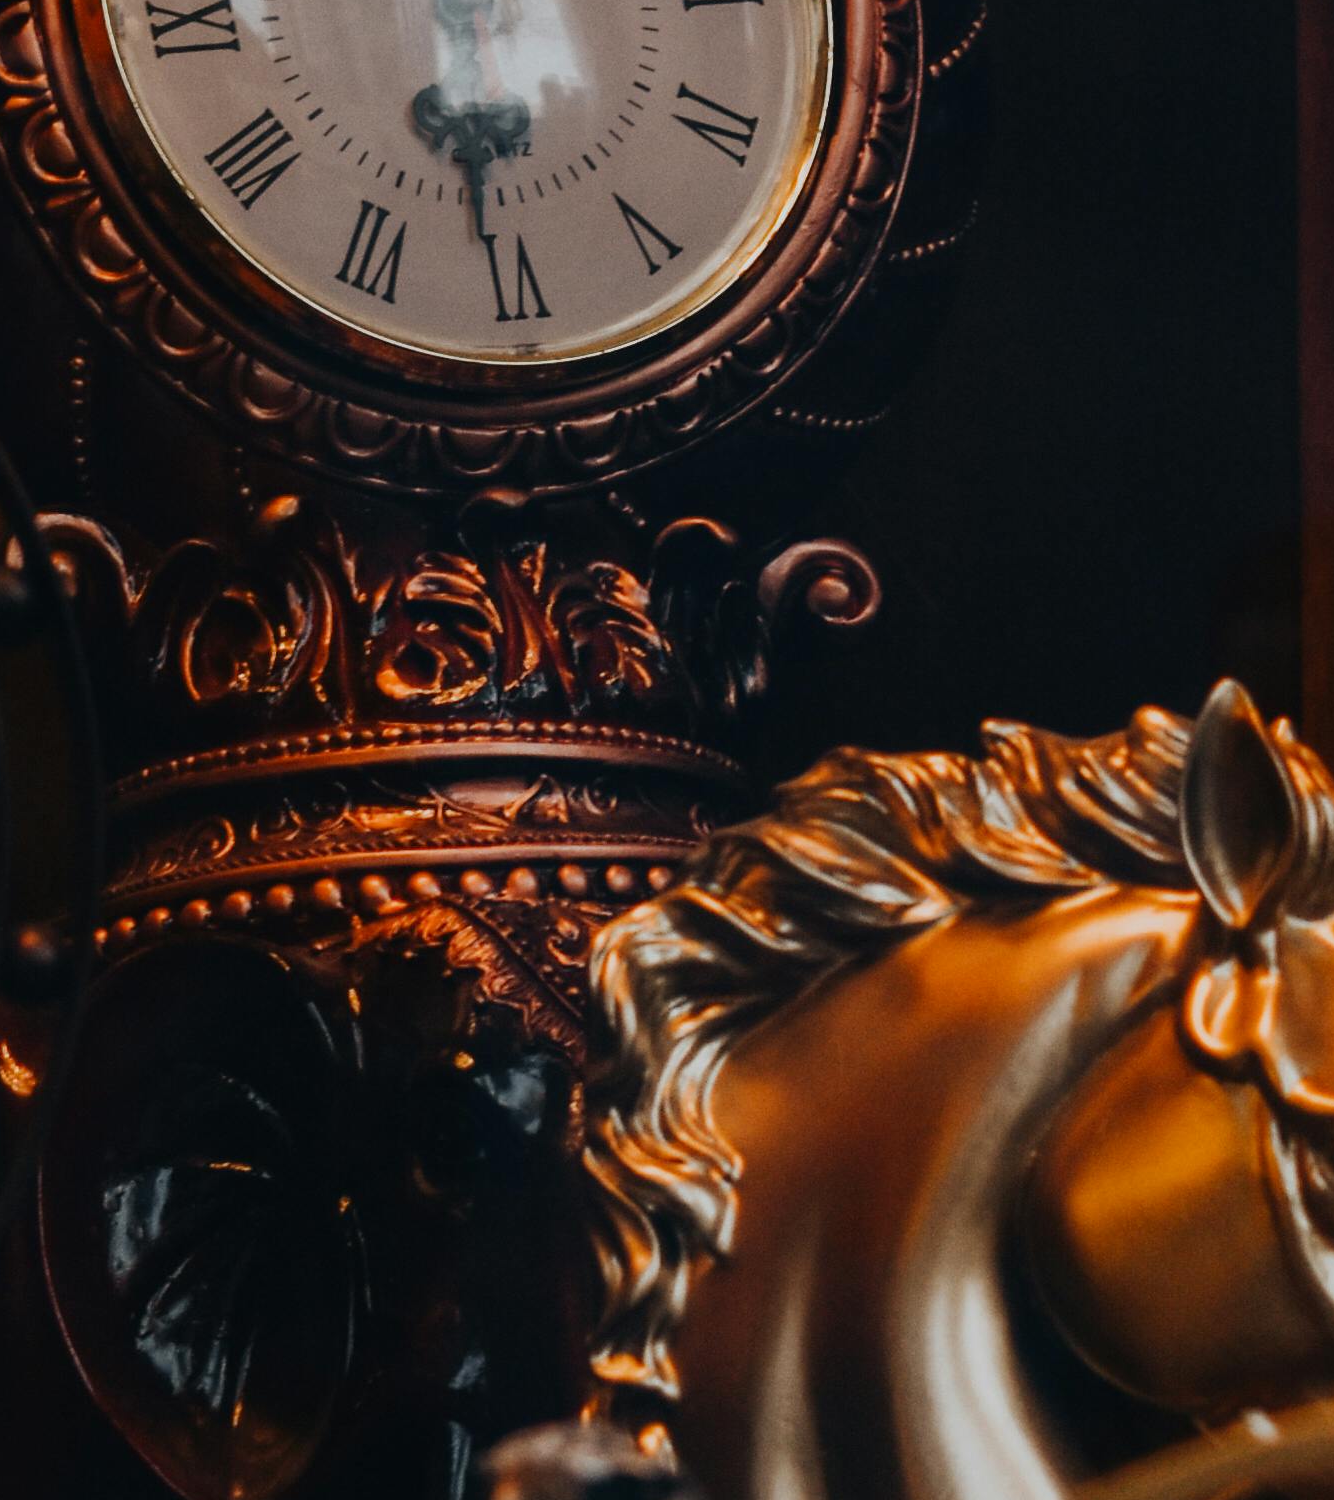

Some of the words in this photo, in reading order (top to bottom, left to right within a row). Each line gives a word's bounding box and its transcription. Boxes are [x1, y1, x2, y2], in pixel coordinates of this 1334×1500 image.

[204, 108, 301, 211] VIII
[673, 82, 759, 167] IV
[334, 199, 407, 305] VII
[482, 229, 552, 323] VI
[613, 193, 684, 276] V
